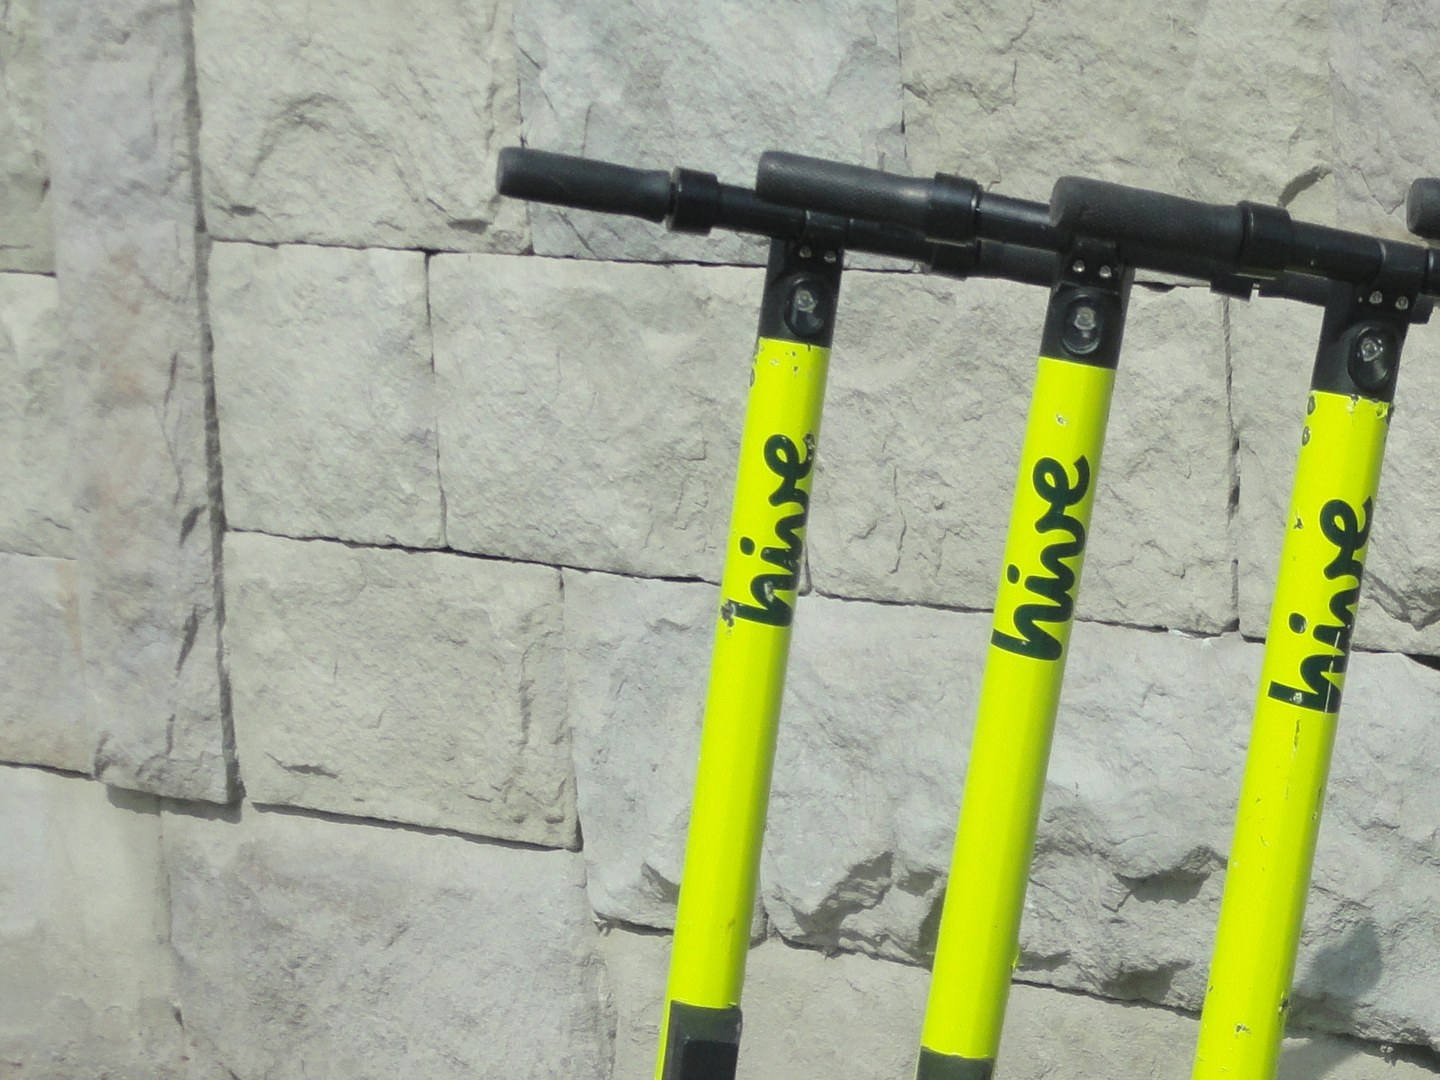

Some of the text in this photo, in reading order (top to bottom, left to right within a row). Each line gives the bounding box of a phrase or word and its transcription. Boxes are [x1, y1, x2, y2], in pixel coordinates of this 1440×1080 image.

[736, 433, 812, 627] hive
[991, 456, 1090, 660] hive
[1268, 496, 1373, 714] hive
